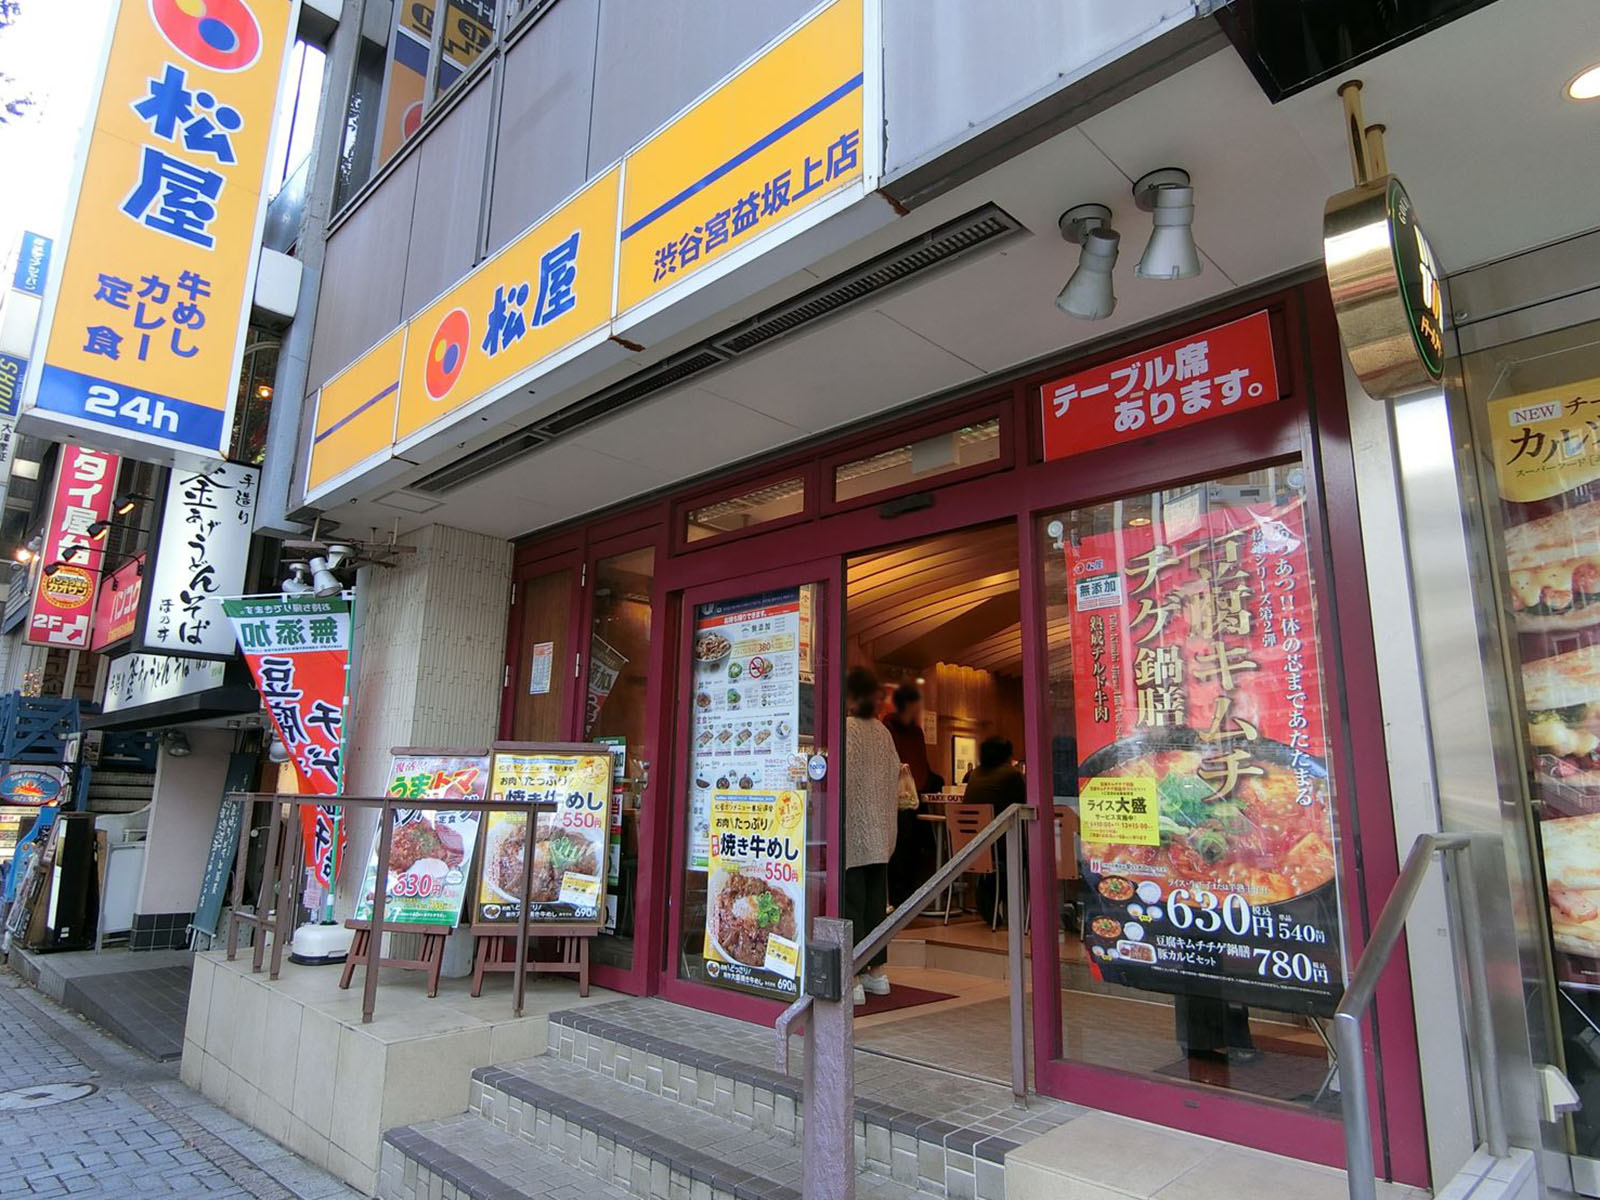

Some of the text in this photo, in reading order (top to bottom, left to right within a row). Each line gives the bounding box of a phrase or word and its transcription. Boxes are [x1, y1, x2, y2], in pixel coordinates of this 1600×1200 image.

[120, 63, 243, 250] 松屋
[653, 129, 860, 282] 渋谷宮益坂上店
[170, 269, 212, 359] 牛めし
[482, 229, 582, 358] 松屋
[82, 272, 134, 361] 定食
[132, 274, 171, 361] カレー
[1053, 340, 1209, 418] テーブル席
[1114, 368, 1263, 432] あります。
[84, 384, 180, 433] 24h
[1514, 404, 1556, 423] NEW
[56, 446, 108, 565] タイ屋台
[1079, 580, 1117, 598] 無添加
[33, 613, 62, 629] 2F
[1124, 544, 1186, 729] チゲ鍋膳
[562, 812, 602, 829] 550円
[734, 817, 768, 831] たっぷり
[1087, 796, 1147, 814] ライス大盛
[720, 833, 799, 861] 焼き牛めし
[765, 862, 799, 882] 550円
[1156, 935, 1250, 959] 豆腐キムチチゲ鍋膳
[1279, 922, 1325, 943] 540円
[1253, 948, 1329, 984] 780円
